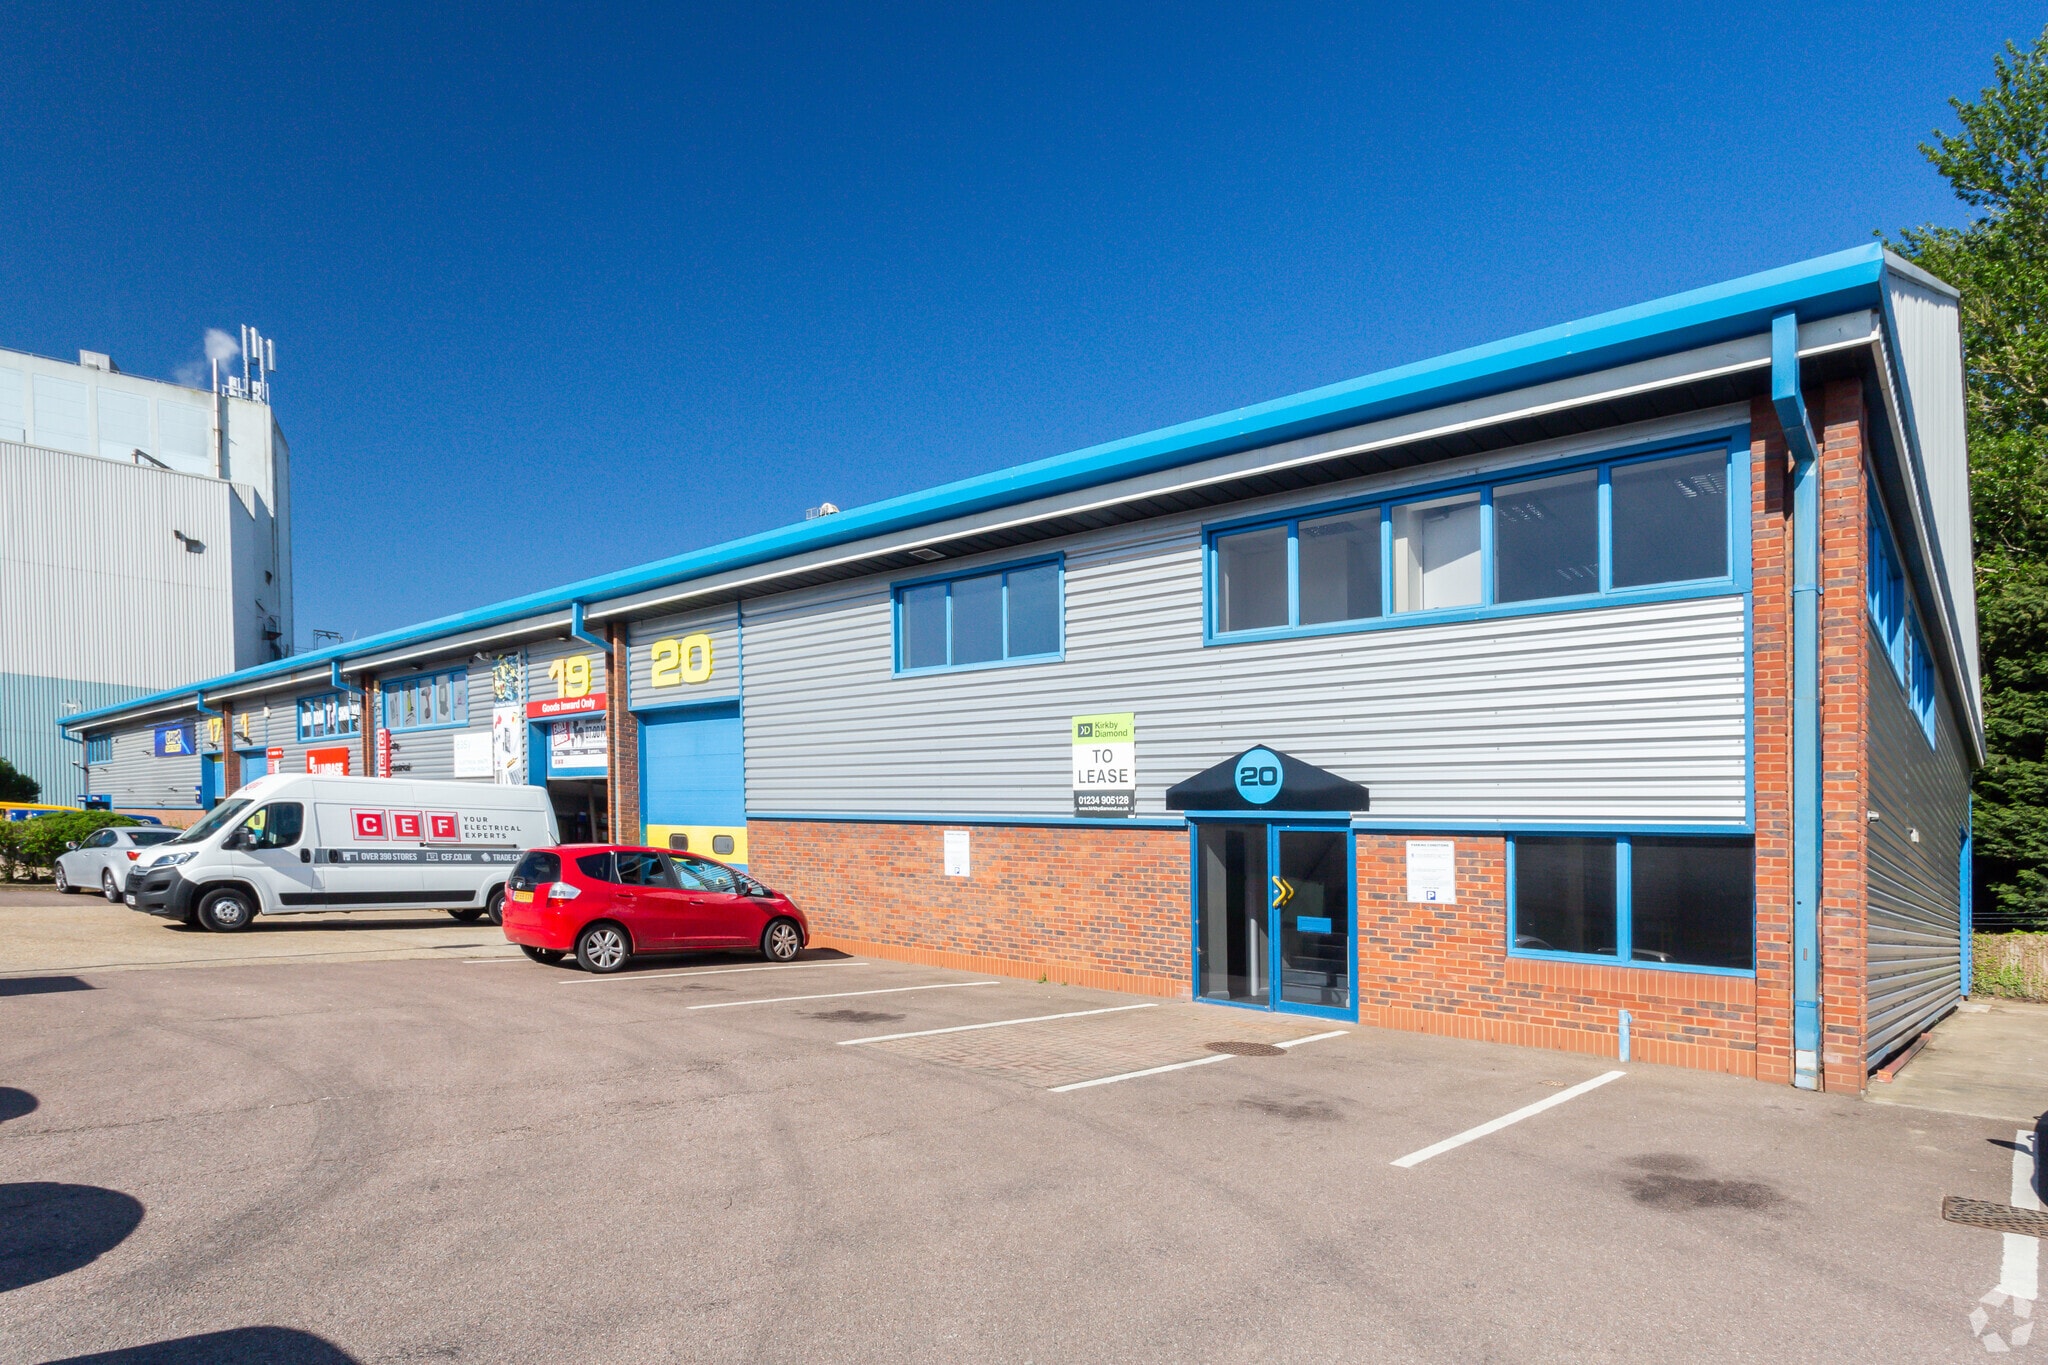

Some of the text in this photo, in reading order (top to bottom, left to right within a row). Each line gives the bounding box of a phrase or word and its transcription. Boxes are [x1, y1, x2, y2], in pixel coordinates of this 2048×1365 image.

[651, 634, 712, 688] 20
[548, 655, 591, 699] 19
[542, 698, 596, 713] Goods Inward Only
[207, 717, 223, 742] 17
[1094, 721, 1118, 730] Kirkby
[1094, 729, 1128, 738] Diamond
[1092, 749, 1113, 763] TO
[1078, 768, 1129, 784] LEASE
[1240, 766, 1278, 786] 20
[1078, 795, 1129, 805] 01234 905128
[464, 824, 522, 832] ELECTRICAL
[392, 853, 418, 861] STORES
[441, 853, 472, 861] CEF.CO.UK
[493, 854, 512, 862] TRADE
